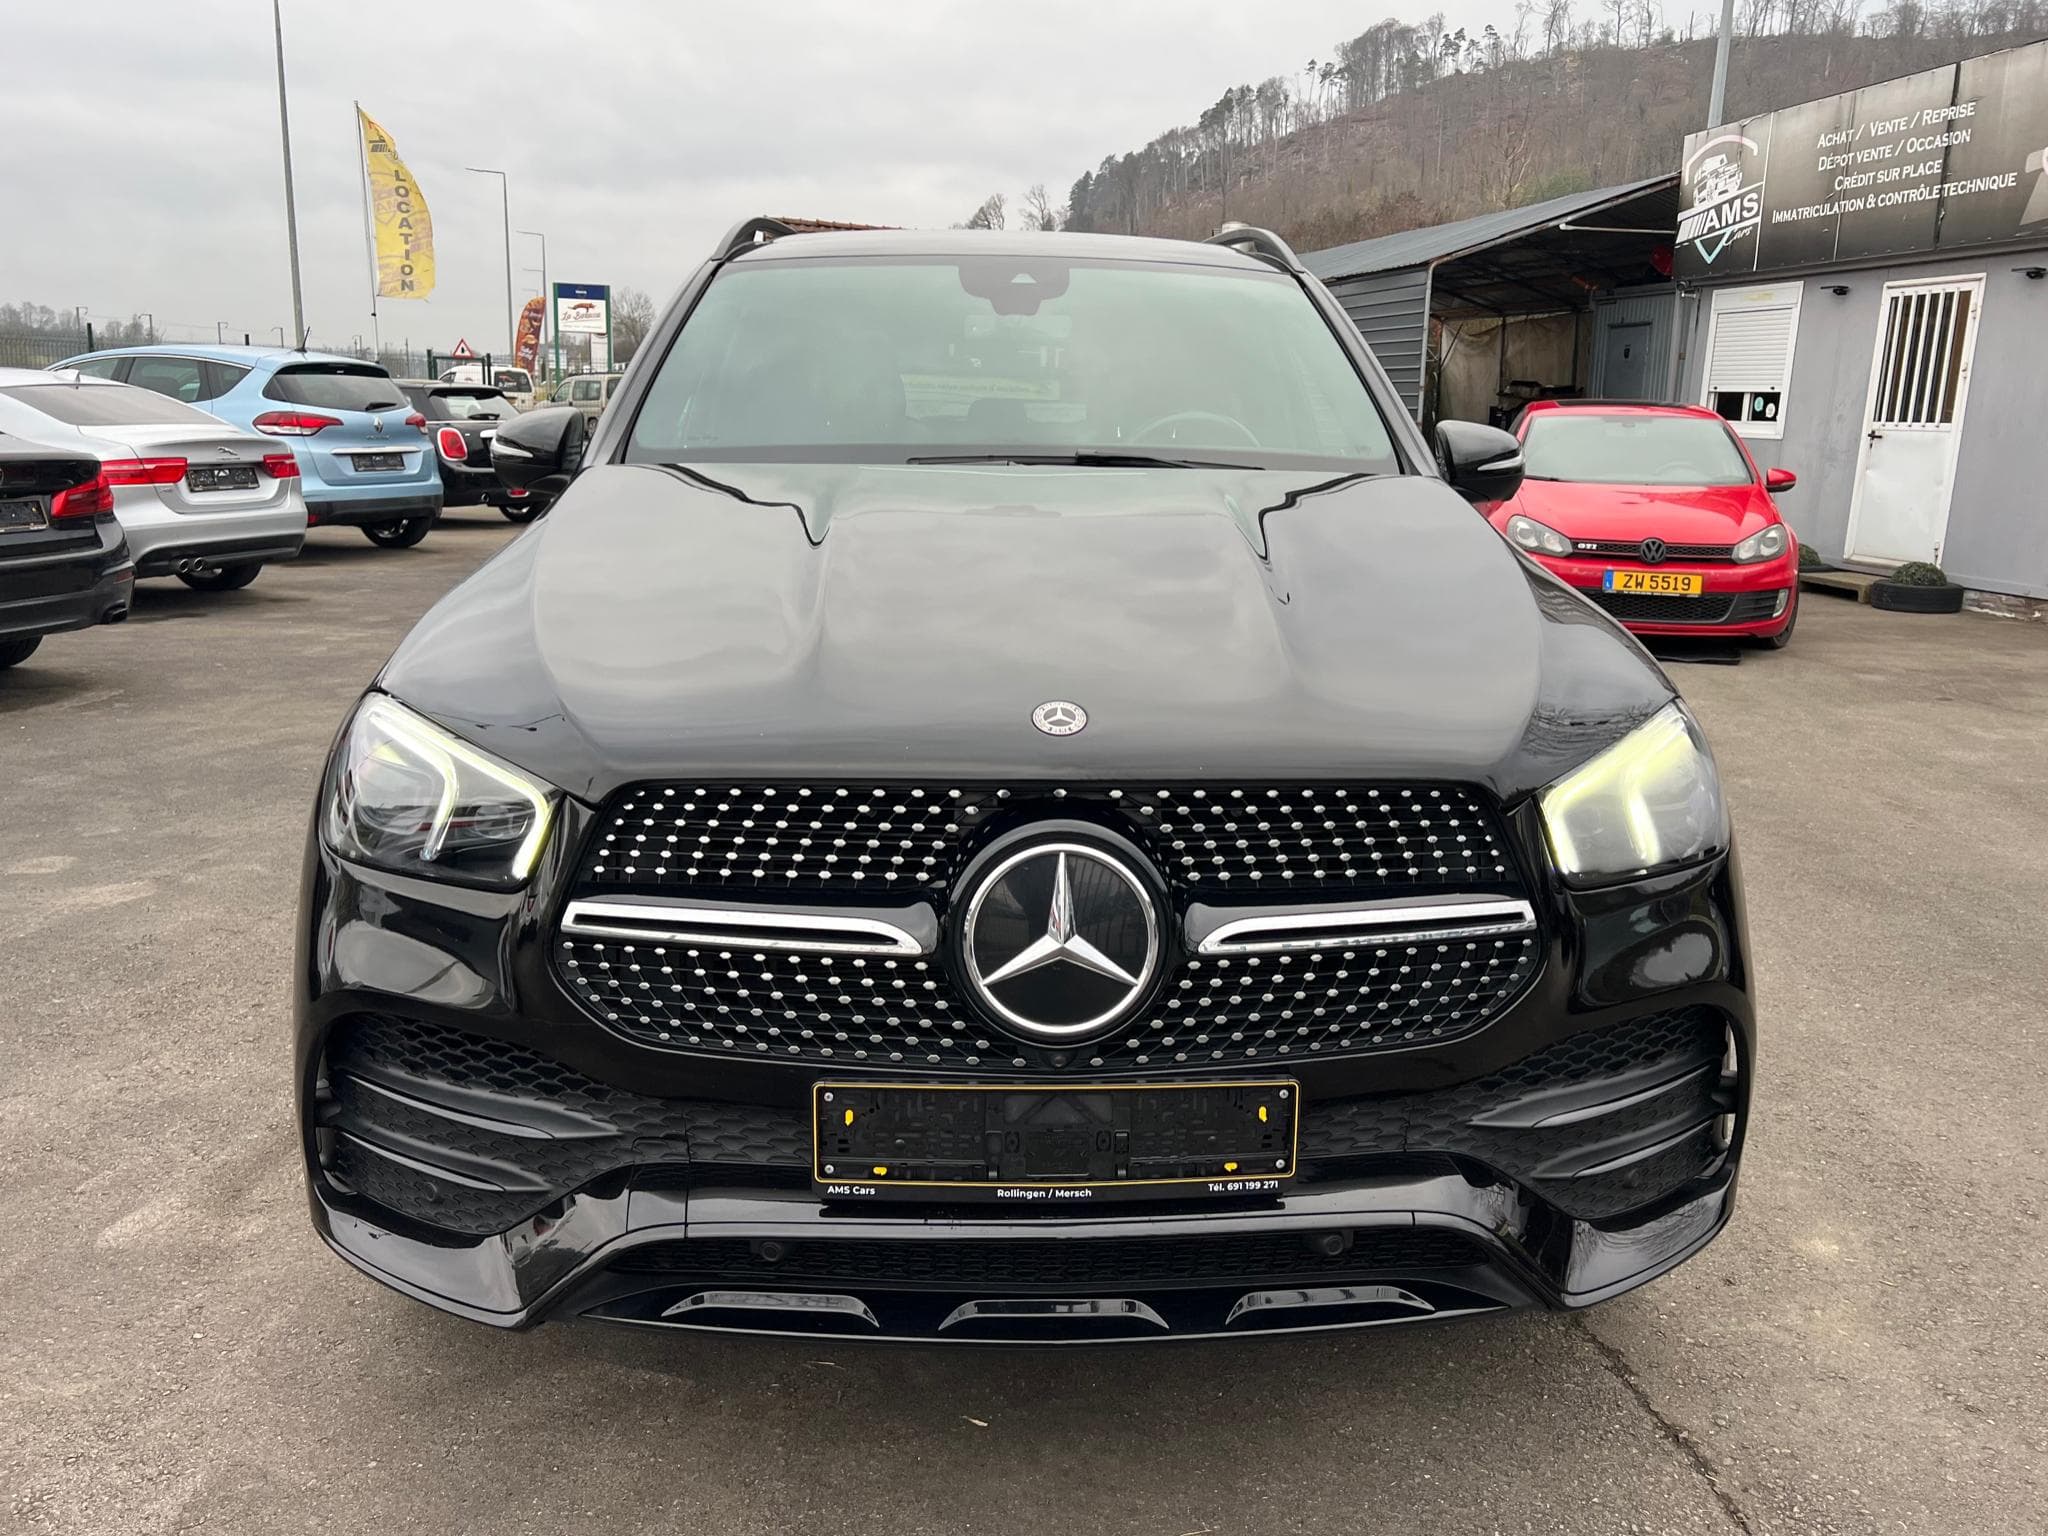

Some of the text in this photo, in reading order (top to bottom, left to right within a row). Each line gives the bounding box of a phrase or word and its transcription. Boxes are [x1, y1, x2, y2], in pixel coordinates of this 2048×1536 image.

[1817, 129, 1855, 149] ACHAT
[1870, 117, 1908, 137] VENTE
[1921, 102, 1977, 126] REPRISE
[1856, 144, 1894, 164] VENTE
[1906, 129, 1972, 154] OCCASION
[1834, 159, 1943, 191] CRÉDIT SUR PLACE
[1702, 192, 1759, 235] AMS
[1771, 172, 2018, 224] IMMATRICULATION & CONTRÔLE TECHNIQUE
[394, 169, 414, 291] LOCATION
[1577, 542, 1598, 550] GTI
[1623, 573, 1691, 592] ZW 5519
[827, 1185, 876, 1195] AMS Cars
[997, 1188, 1092, 1200] Rollingen / Mersch
[1227, 1181, 1243, 1191] 691
[1245, 1181, 1261, 1190] 199
[1263, 1180, 1279, 1189] 271
